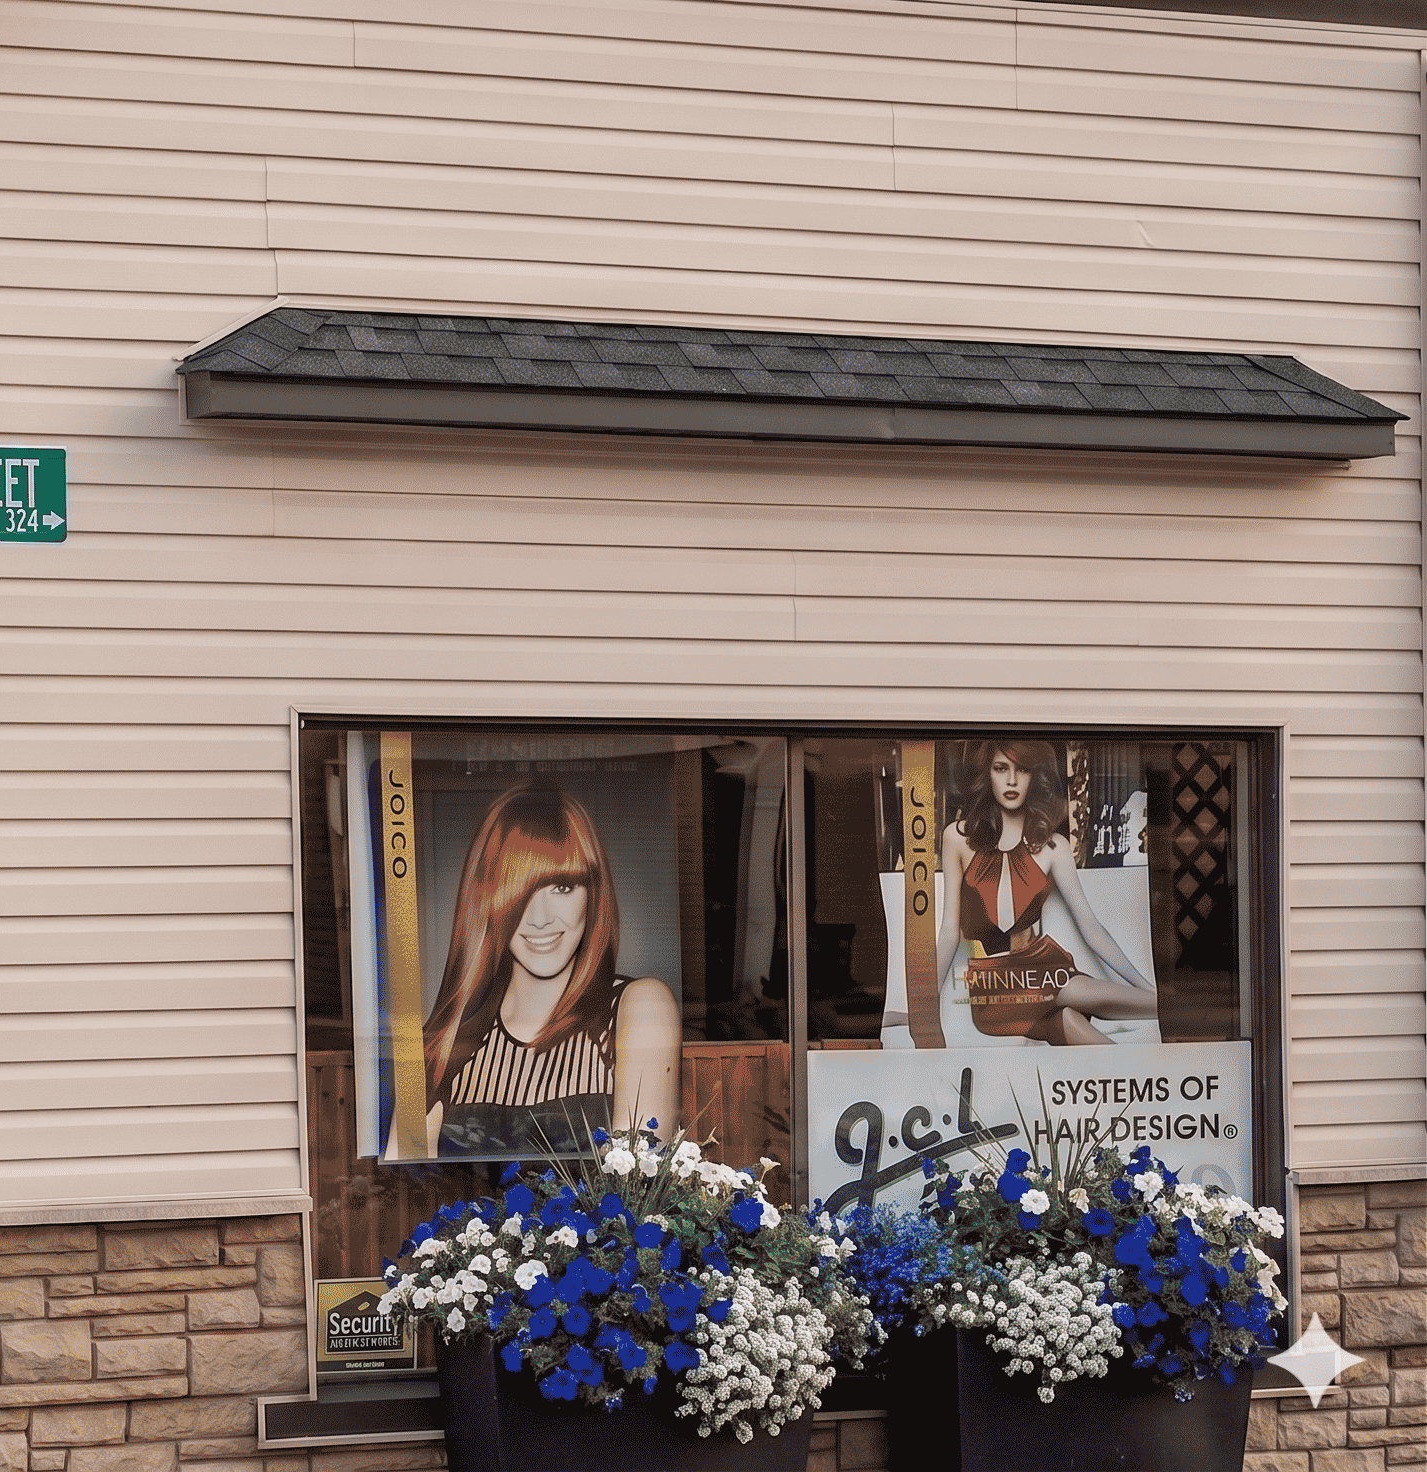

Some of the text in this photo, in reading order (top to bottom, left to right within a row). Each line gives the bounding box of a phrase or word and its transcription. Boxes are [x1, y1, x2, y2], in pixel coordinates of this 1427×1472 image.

[5, 508, 39, 533] 324
[389, 769, 408, 879] JOICO
[910, 786, 929, 917] JOICO
[1051, 1075, 1220, 1106] SYSTEMS OF
[1034, 1116, 1101, 1145] HAIR
